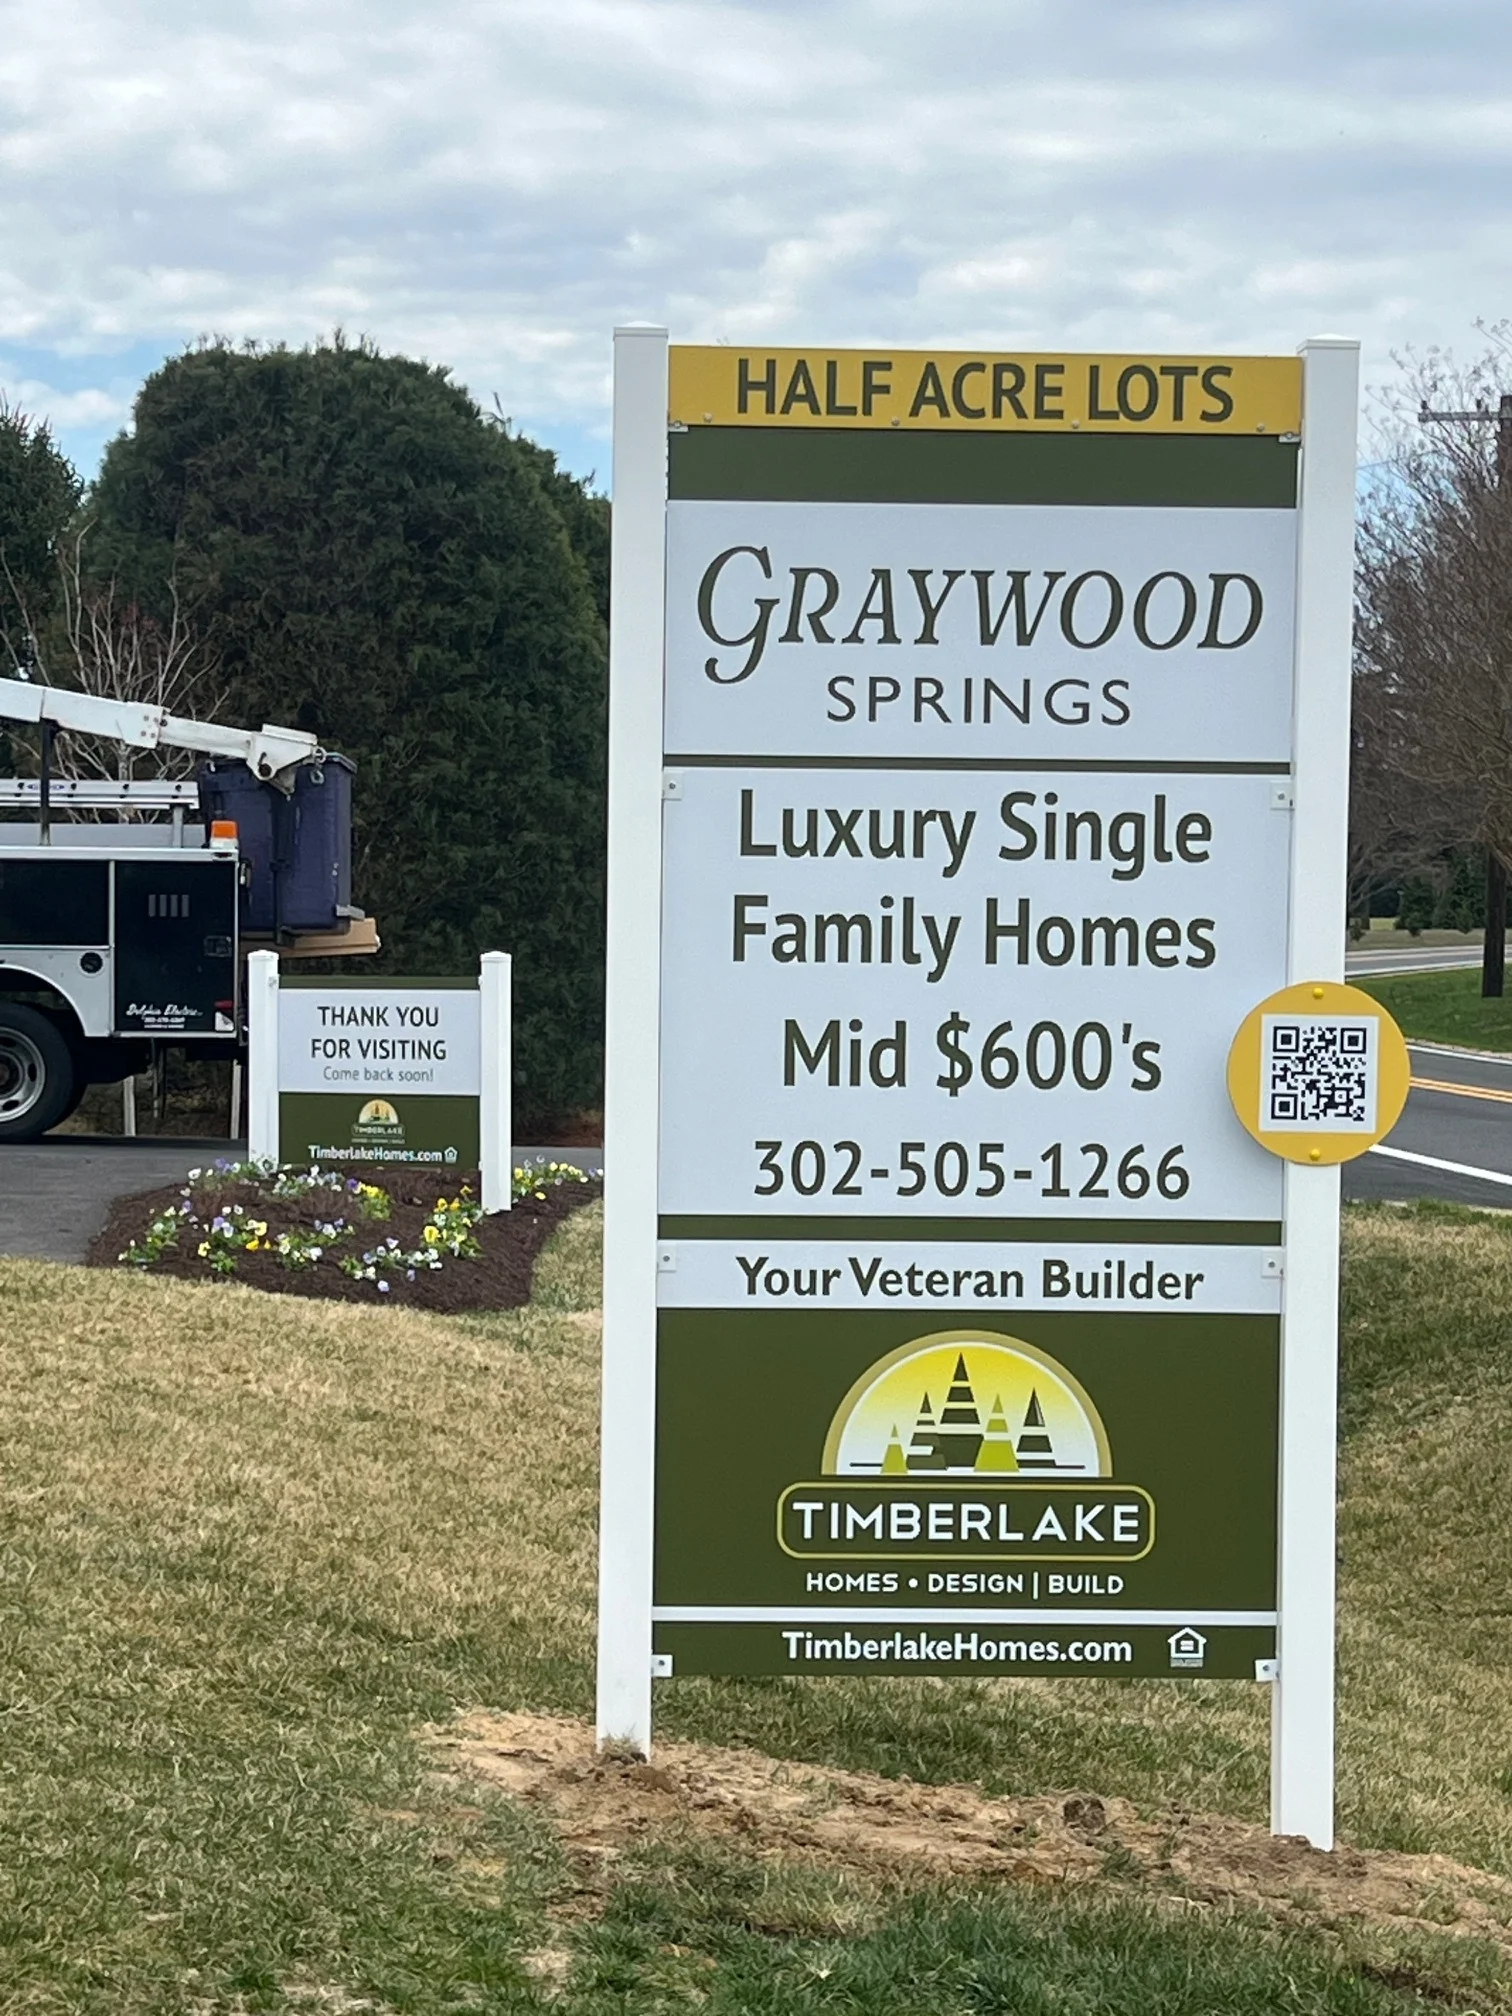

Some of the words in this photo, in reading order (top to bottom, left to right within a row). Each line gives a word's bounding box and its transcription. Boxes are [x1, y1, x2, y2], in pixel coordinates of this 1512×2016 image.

[737, 357, 893, 417] HALF
[908, 361, 1066, 420] ACRE
[1088, 364, 1234, 423] LOTS
[697, 546, 1264, 684] GRAYWOOD
[827, 675, 1131, 726] SPRINGS
[739, 788, 977, 879] Luxury
[998, 790, 1212, 882] Single
[732, 894, 962, 984] Family
[985, 897, 1216, 969] Homes
[316, 1005, 390, 1027] THANK
[395, 1006, 439, 1028] YOU
[311, 1038, 351, 1059] FOR
[357, 1038, 447, 1061] VISITING
[783, 1018, 907, 1088] Mid
[936, 1011, 1162, 1098] $600's
[323, 1065, 360, 1081] Come
[363, 1066, 394, 1082] back
[398, 1068, 434, 1083] soon!
[307, 1145, 443, 1162] TimberlakeHomes.com
[754, 1140, 1190, 1200] 302-505-1266
[735, 1256, 842, 1296] Your
[847, 1256, 1024, 1298] Veteran
[1042, 1259, 1205, 1300] Builder
[792, 1502, 1141, 1542] TIMBERLAKE
[806, 1572, 899, 1592] HOMES
[928, 1573, 1023, 1594] DESIGN
[1048, 1574, 1124, 1594] BUILD
[781, 1631, 1132, 1662] TimberlakeHomes.com
